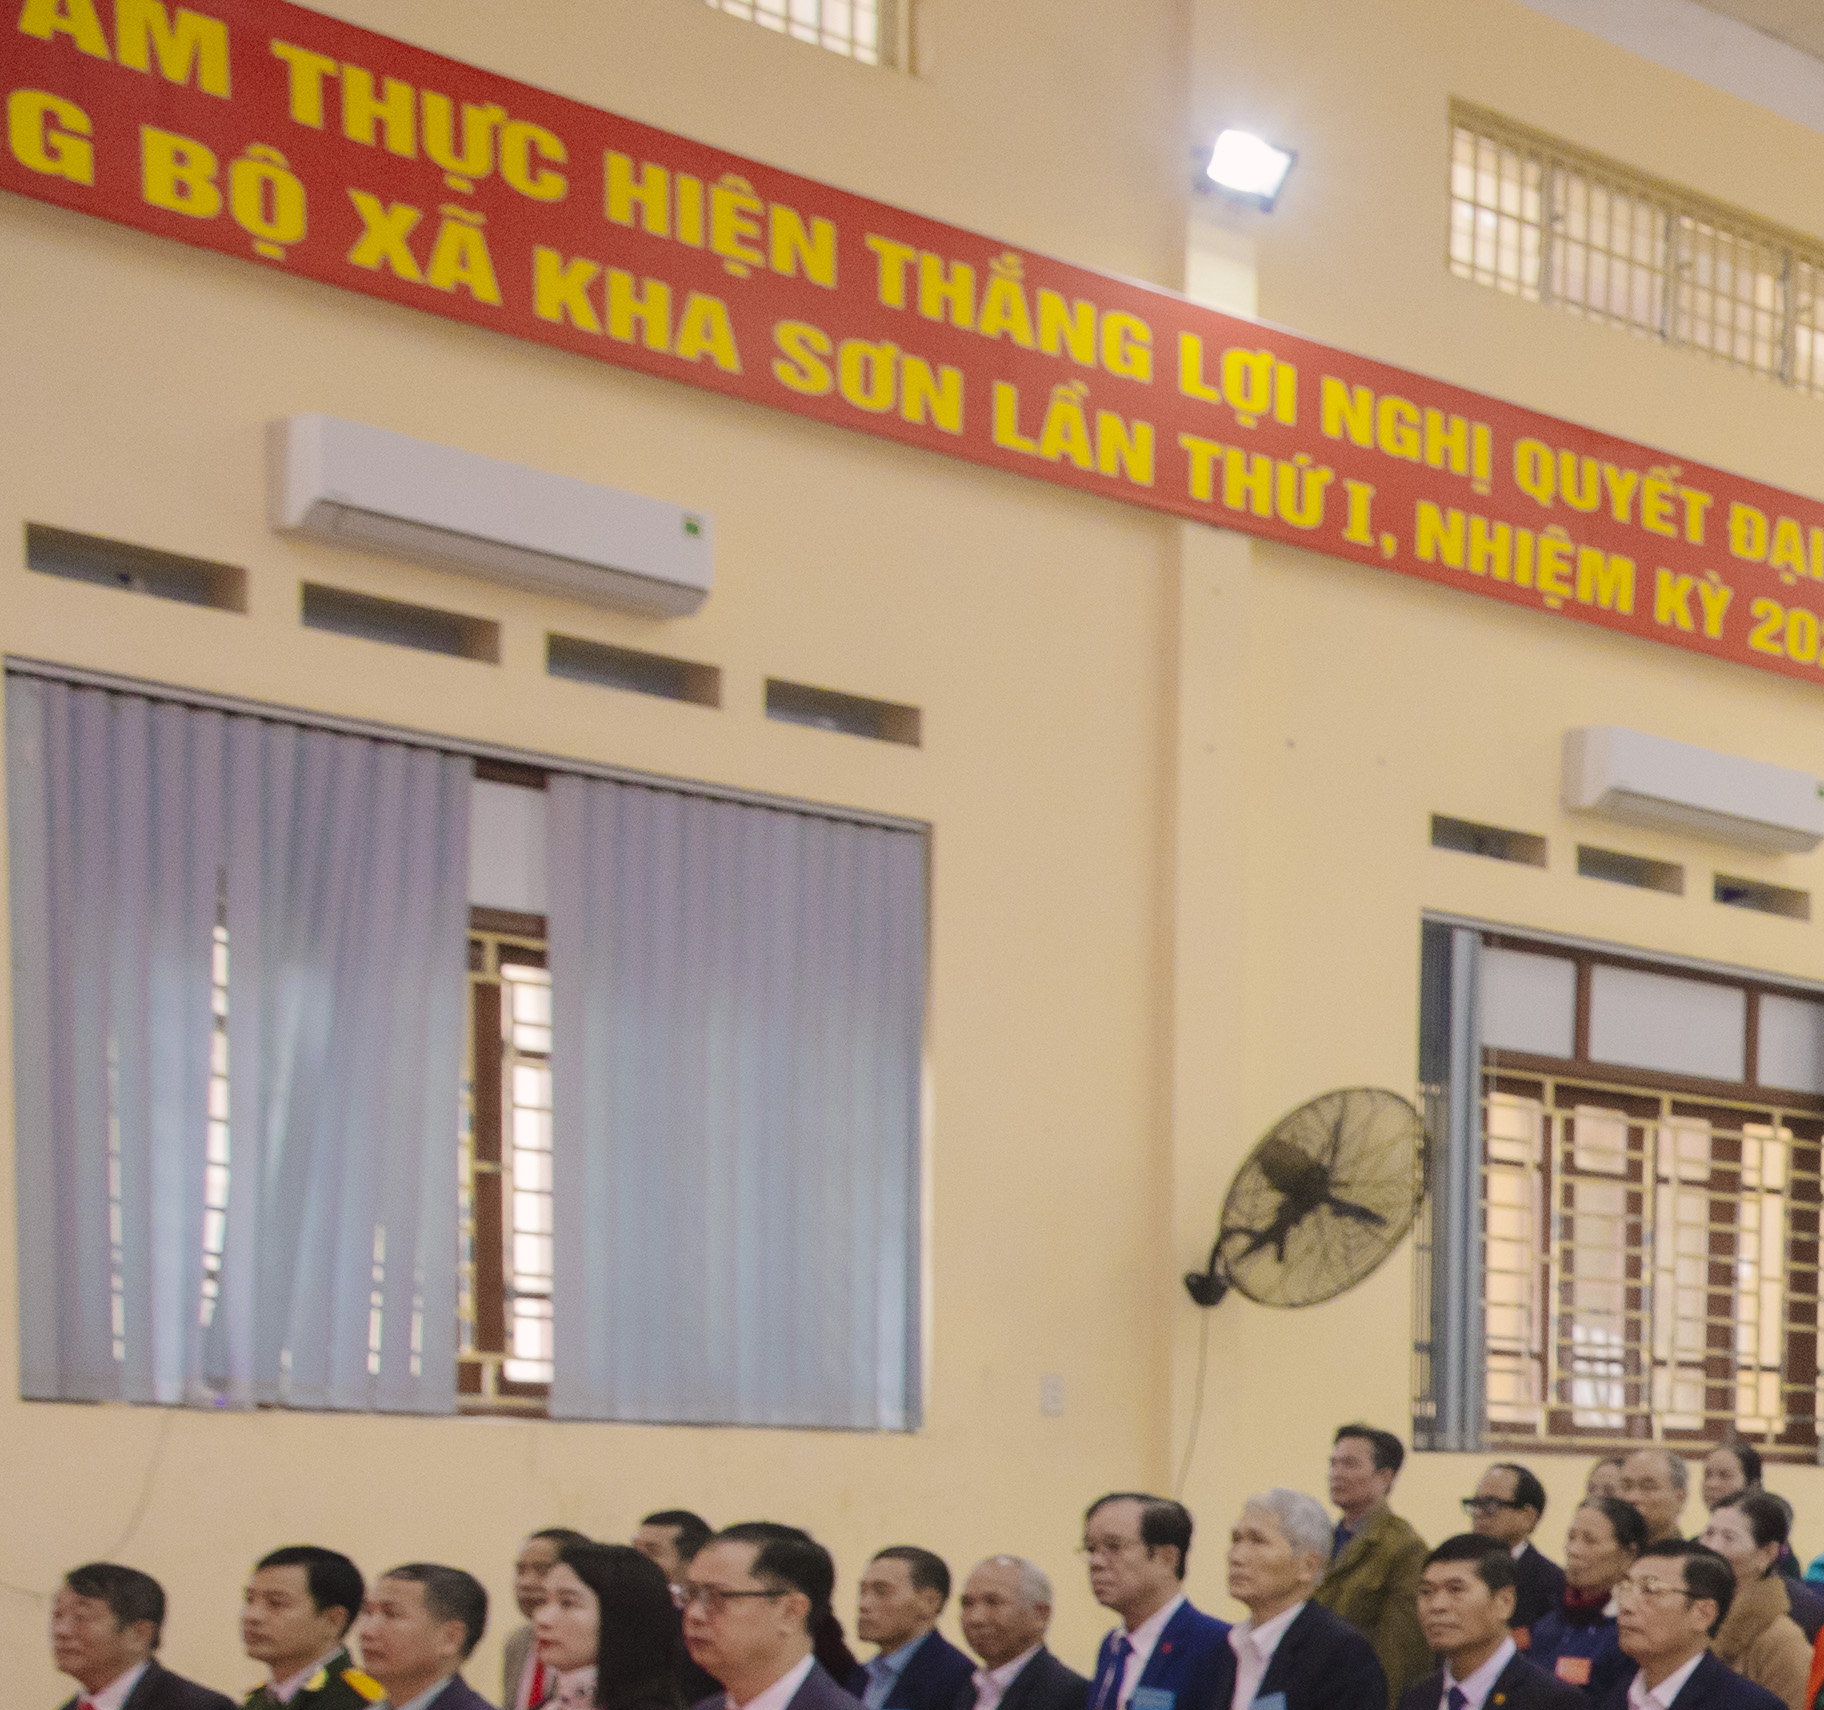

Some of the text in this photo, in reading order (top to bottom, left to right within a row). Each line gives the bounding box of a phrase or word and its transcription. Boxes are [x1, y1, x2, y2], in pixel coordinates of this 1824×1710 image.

[140, 124, 308, 262] BỘ
[347, 187, 503, 307] XÃ
[531, 245, 742, 373] KHA
[771, 318, 964, 436] SƠN
[991, 379, 1154, 486] LẦN
[1179, 434, 1333, 530] THỨ
[1415, 501, 1635, 615] NHIỆM
[1654, 567, 1733, 640] KỲ
[271, 38, 568, 201] THỰC
[604, 149, 837, 288] HIỆN
[866, 232, 1152, 384] THẮNG
[1178, 332, 1297, 428] LỢI
[1321, 377, 1491, 495] NGHỊ
[1513, 437, 1713, 545] QUYẾT
